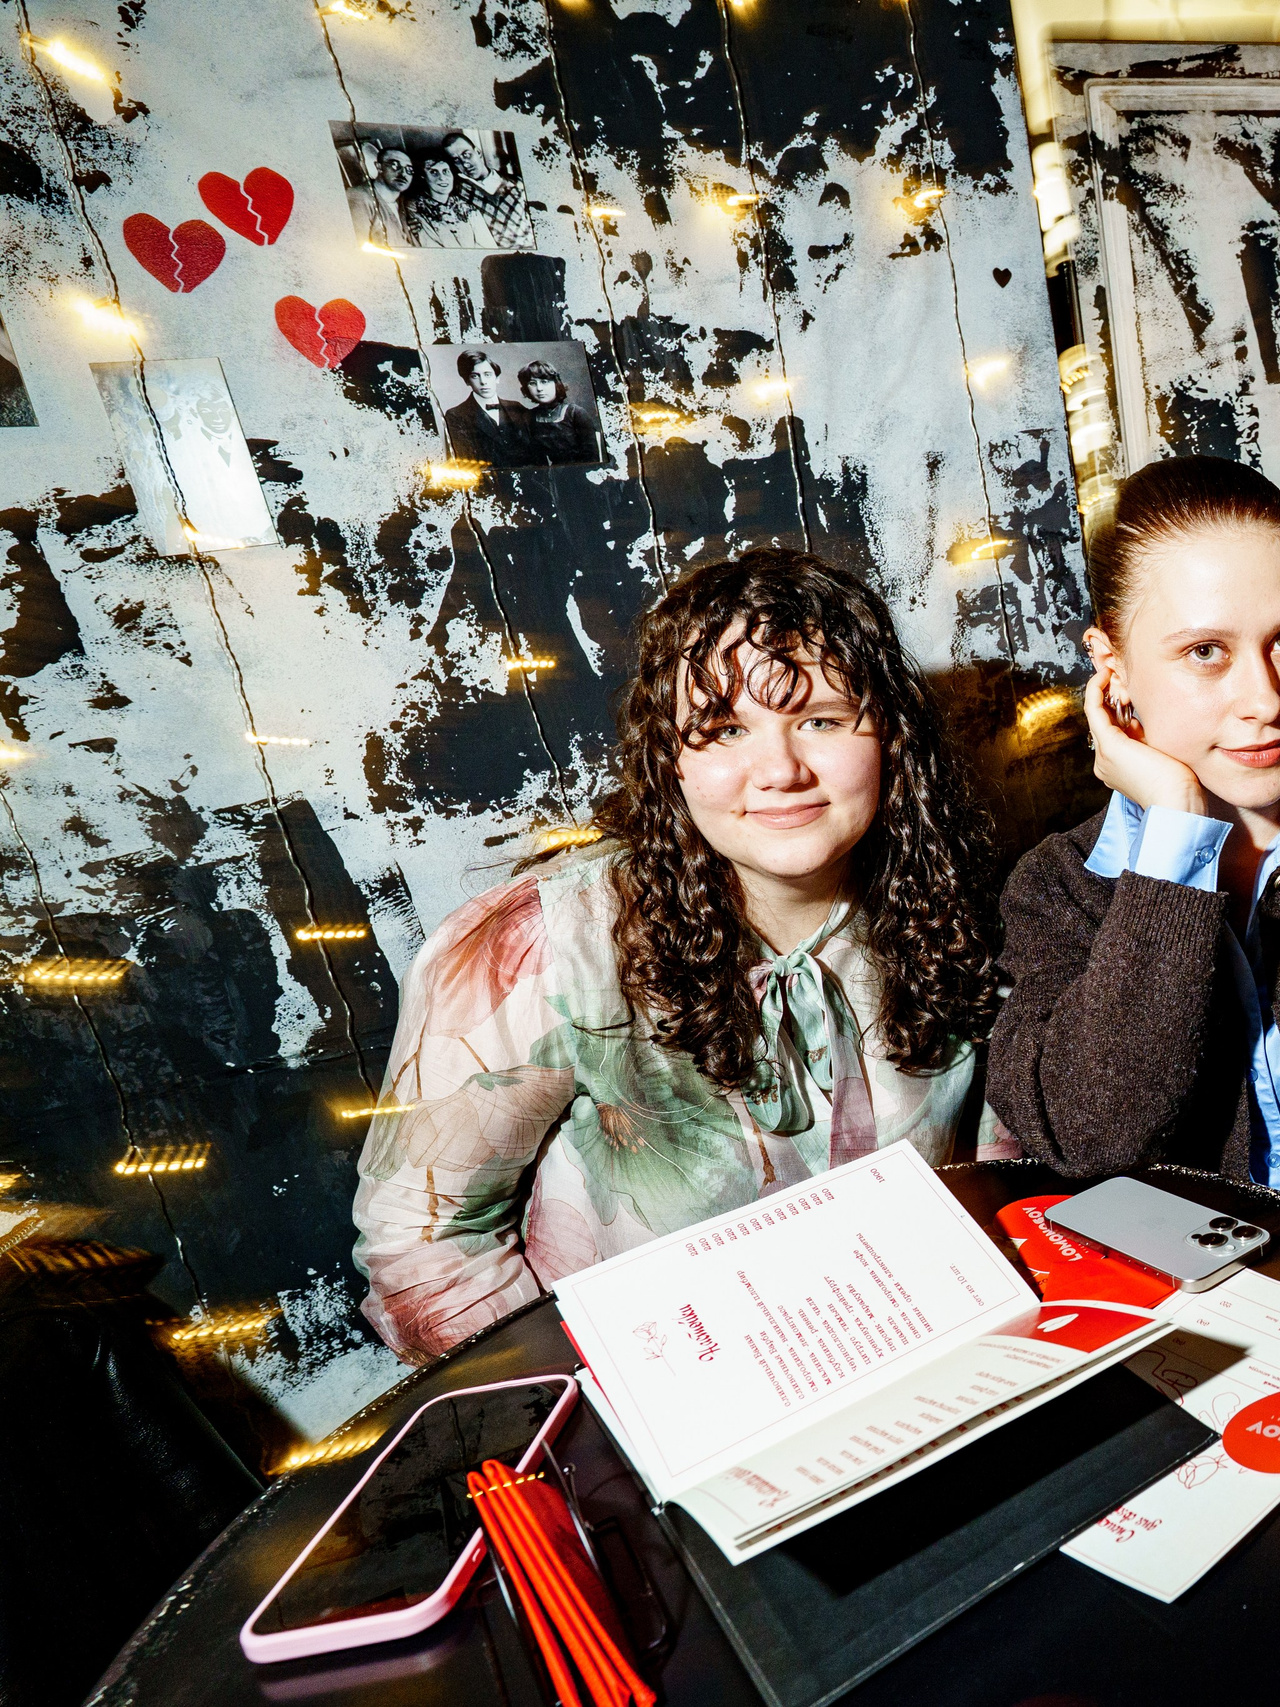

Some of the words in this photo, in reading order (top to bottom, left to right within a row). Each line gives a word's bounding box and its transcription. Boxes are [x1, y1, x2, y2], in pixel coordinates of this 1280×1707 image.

[870, 1168, 885, 1183] 1900
[799, 1198, 811, 1210] 220
[810, 1193, 823, 1205] 220
[822, 1188, 834, 1200] 220
[762, 1213, 775, 1225] 220
[774, 1208, 787, 1220] 220
[787, 1203, 799, 1215] 220
[725, 1228, 737, 1241] 220
[737, 1223, 750, 1236] 220
[750, 1218, 762, 1231] 220
[686, 1243, 698, 1256] 220
[699, 1238, 711, 1251] 220
[712, 1233, 724, 1246] 220
[853, 1250, 869, 1267] кофе
[737, 1271, 760, 1301] пломбир
[824, 1276, 853, 1313] грейпфрут
[870, 1270, 899, 1307] смородина
[894, 1282, 911, 1302] орехи
[806, 1297, 820, 1316] чили
[847, 1284, 874, 1319] маракуйя
[757, 1301, 788, 1342] ванильный
[778, 1305, 809, 1347] лемонграсс
[798, 1309, 818, 1334] ревень
[827, 1304, 849, 1332] тимьян
[888, 1316, 909, 1345] щавель
[901, 1312, 921, 1338] свекла
[678, 1304, 720, 1361] Настойки
[760, 1331, 777, 1354] Барби
[855, 1317, 884, 1358] хреновуха
[875, 1324, 896, 1352] персик
[744, 1335, 762, 1359] Банан
[818, 1338, 845, 1378] клубника
[822, 1320, 856, 1371] черноплодка
[850, 1337, 871, 1365] цитрус
[775, 1355, 804, 1399] сливочная
[789, 1347, 818, 1392] смородина
[809, 1353, 832, 1385] малина
[759, 1359, 790, 1406] сливочный
